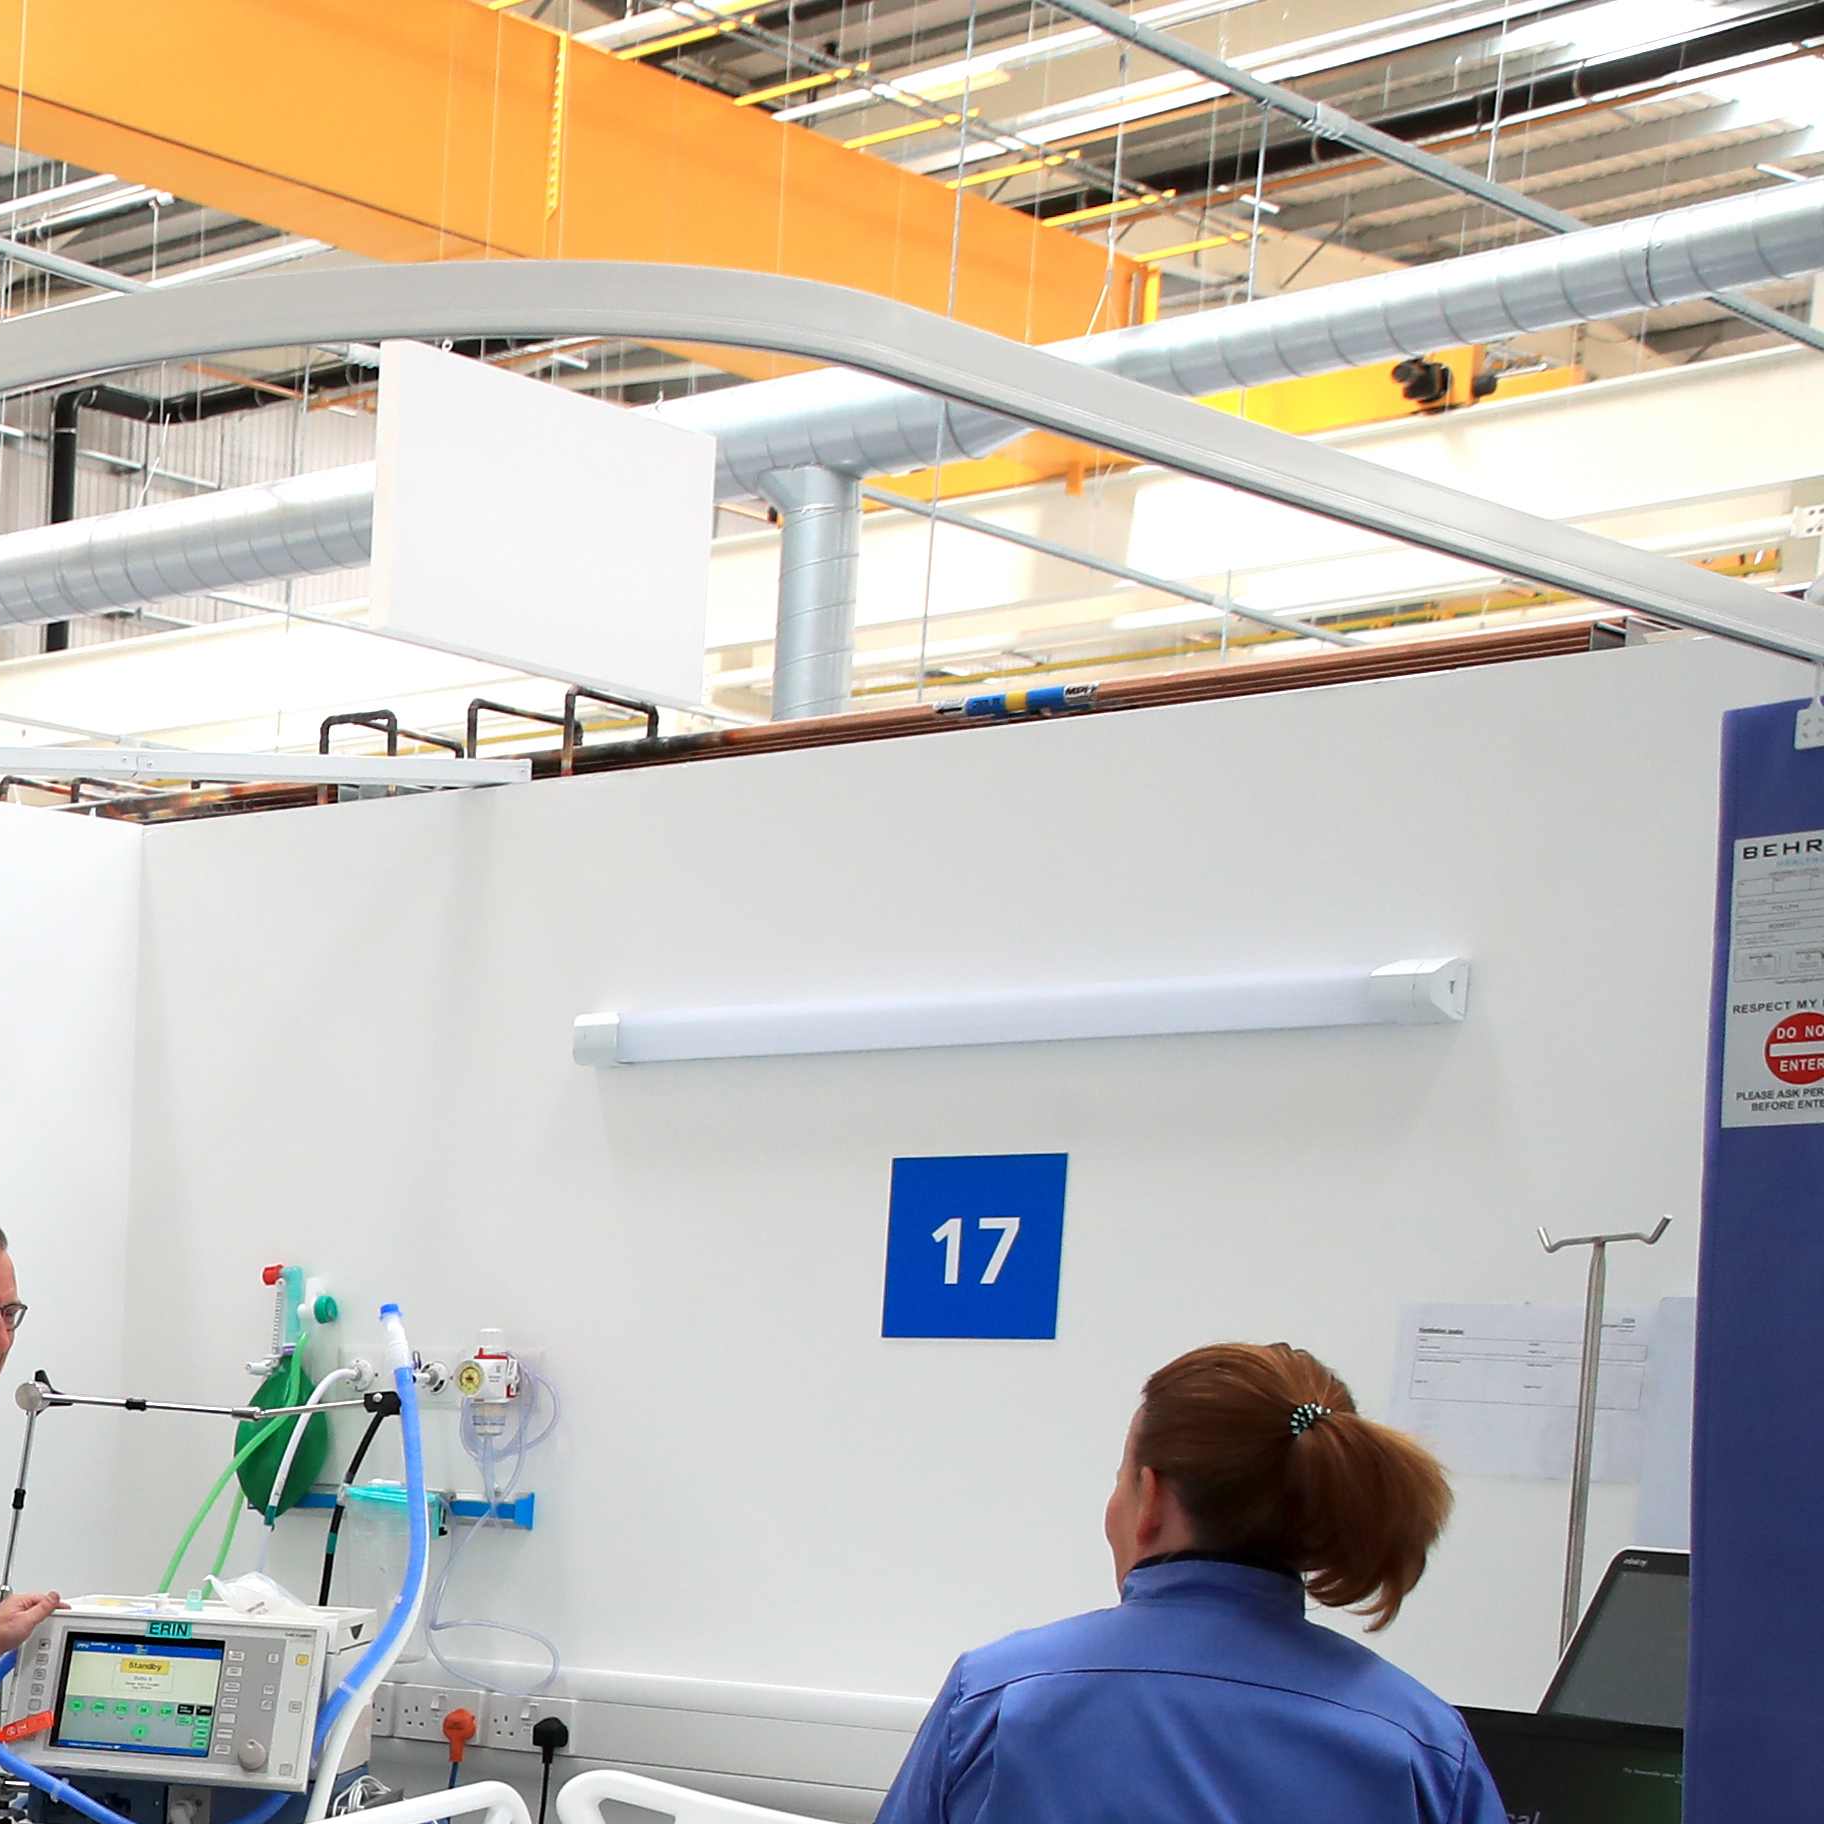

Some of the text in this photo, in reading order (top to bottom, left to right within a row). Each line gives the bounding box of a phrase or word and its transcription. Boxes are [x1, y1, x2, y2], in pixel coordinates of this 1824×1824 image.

[1743, 839, 1823, 860] BEHR
[1733, 1000, 1818, 1015] RESPECT MY
[1776, 1027, 1797, 1040] DO
[1779, 1058, 1824, 1073] ENTER
[1736, 1090, 1775, 1101] PLEASE
[1777, 1089, 1800, 1099] ASK
[1751, 1100, 1797, 1112] BEFORE
[931, 1216, 1021, 1285] 17
[149, 1622, 188, 1636] ERIN
[128, 1661, 163, 1673] Standby
